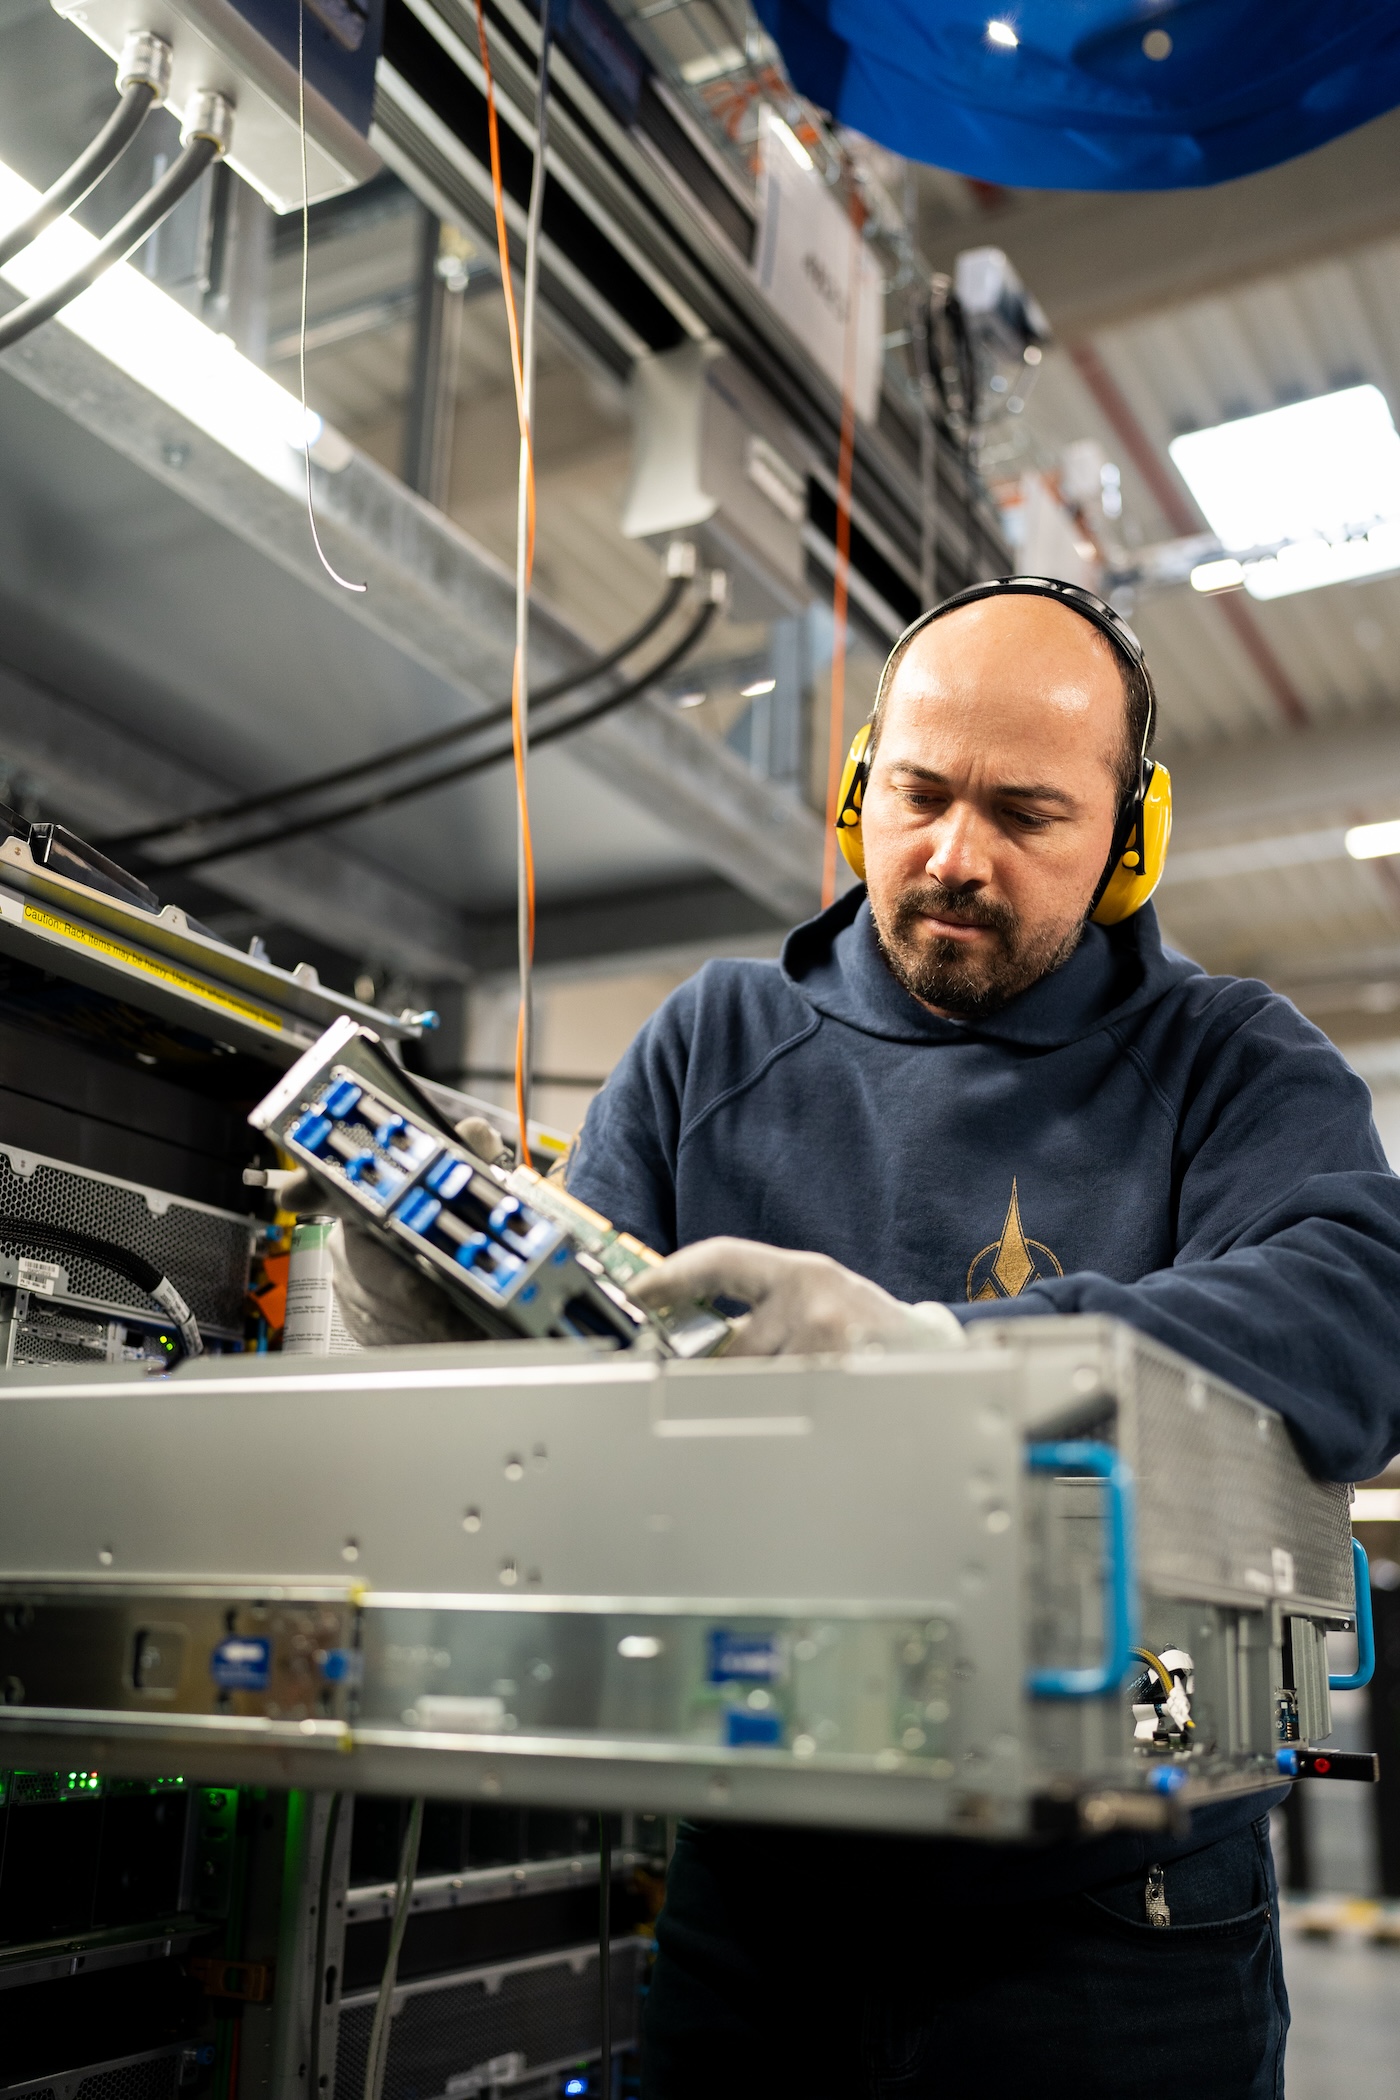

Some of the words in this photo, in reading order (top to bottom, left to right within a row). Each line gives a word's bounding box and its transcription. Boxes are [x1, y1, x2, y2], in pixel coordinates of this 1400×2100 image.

[24, 905, 62, 931] Caution:
[64, 922, 86, 941] Rack
[88, 933, 111, 951] items
[113, 945, 130, 962] may
[132, 951, 142, 965] be
